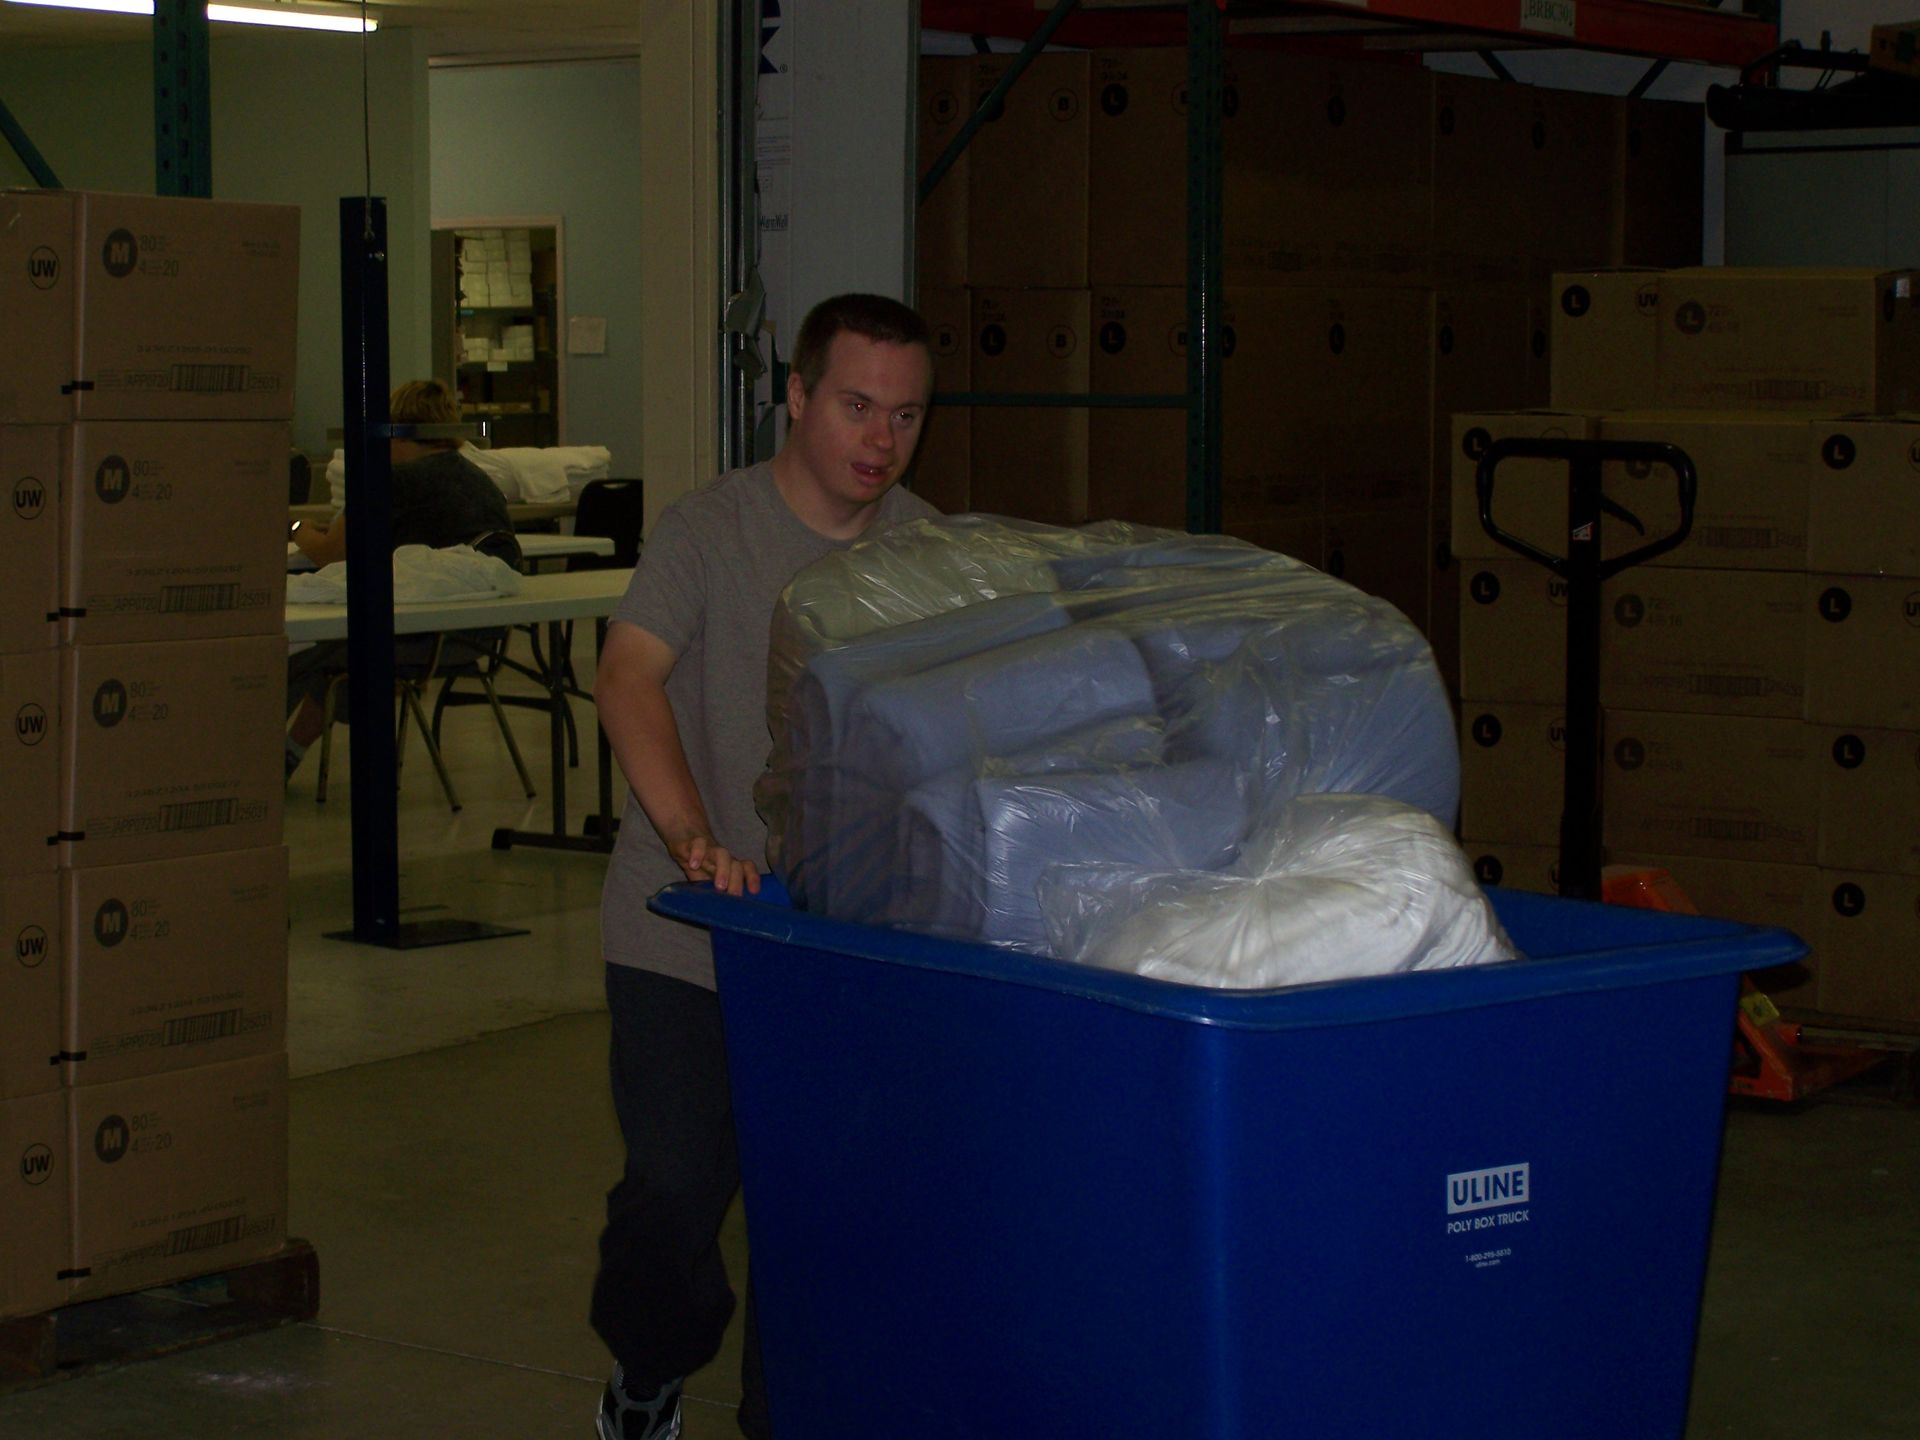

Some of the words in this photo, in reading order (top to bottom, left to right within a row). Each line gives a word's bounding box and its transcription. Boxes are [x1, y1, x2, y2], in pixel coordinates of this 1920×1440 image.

[111, 242, 130, 265] M
[31, 260, 57, 278] UW
[164, 260, 179, 277] 20
[1571, 295, 1581, 308] L
[1687, 311, 1699, 326] L
[1473, 438, 1482, 452] L
[1835, 445, 1845, 460] L
[104, 469, 123, 491] M
[134, 461, 149, 477] 80
[16, 490, 42, 509] UW
[156, 483, 173, 501] 20
[1480, 581, 1490, 596] L
[1624, 603, 1637, 619] L
[1830, 597, 1840, 612] L
[101, 693, 120, 715] M
[131, 681, 146, 698] 80
[153, 703, 169, 721] 20
[19, 715, 44, 735] UW
[1482, 724, 1492, 739] L
[1624, 747, 1637, 762] L
[1843, 744, 1854, 759] L
[1844, 893, 1854, 908] L
[102, 911, 121, 935] M
[131, 900, 147, 918] 80
[155, 920, 170, 938] 20
[19, 937, 45, 958] UW
[103, 1128, 122, 1152] M
[132, 1114, 148, 1132] 80
[155, 1132, 172, 1151] 20
[24, 1155, 51, 1176] UW
[1453, 1170, 1523, 1205] ULINE
[1448, 1219, 1473, 1235] POLY
[1475, 1215, 1496, 1230] BOX
[1498, 1210, 1530, 1226] TRUCK
